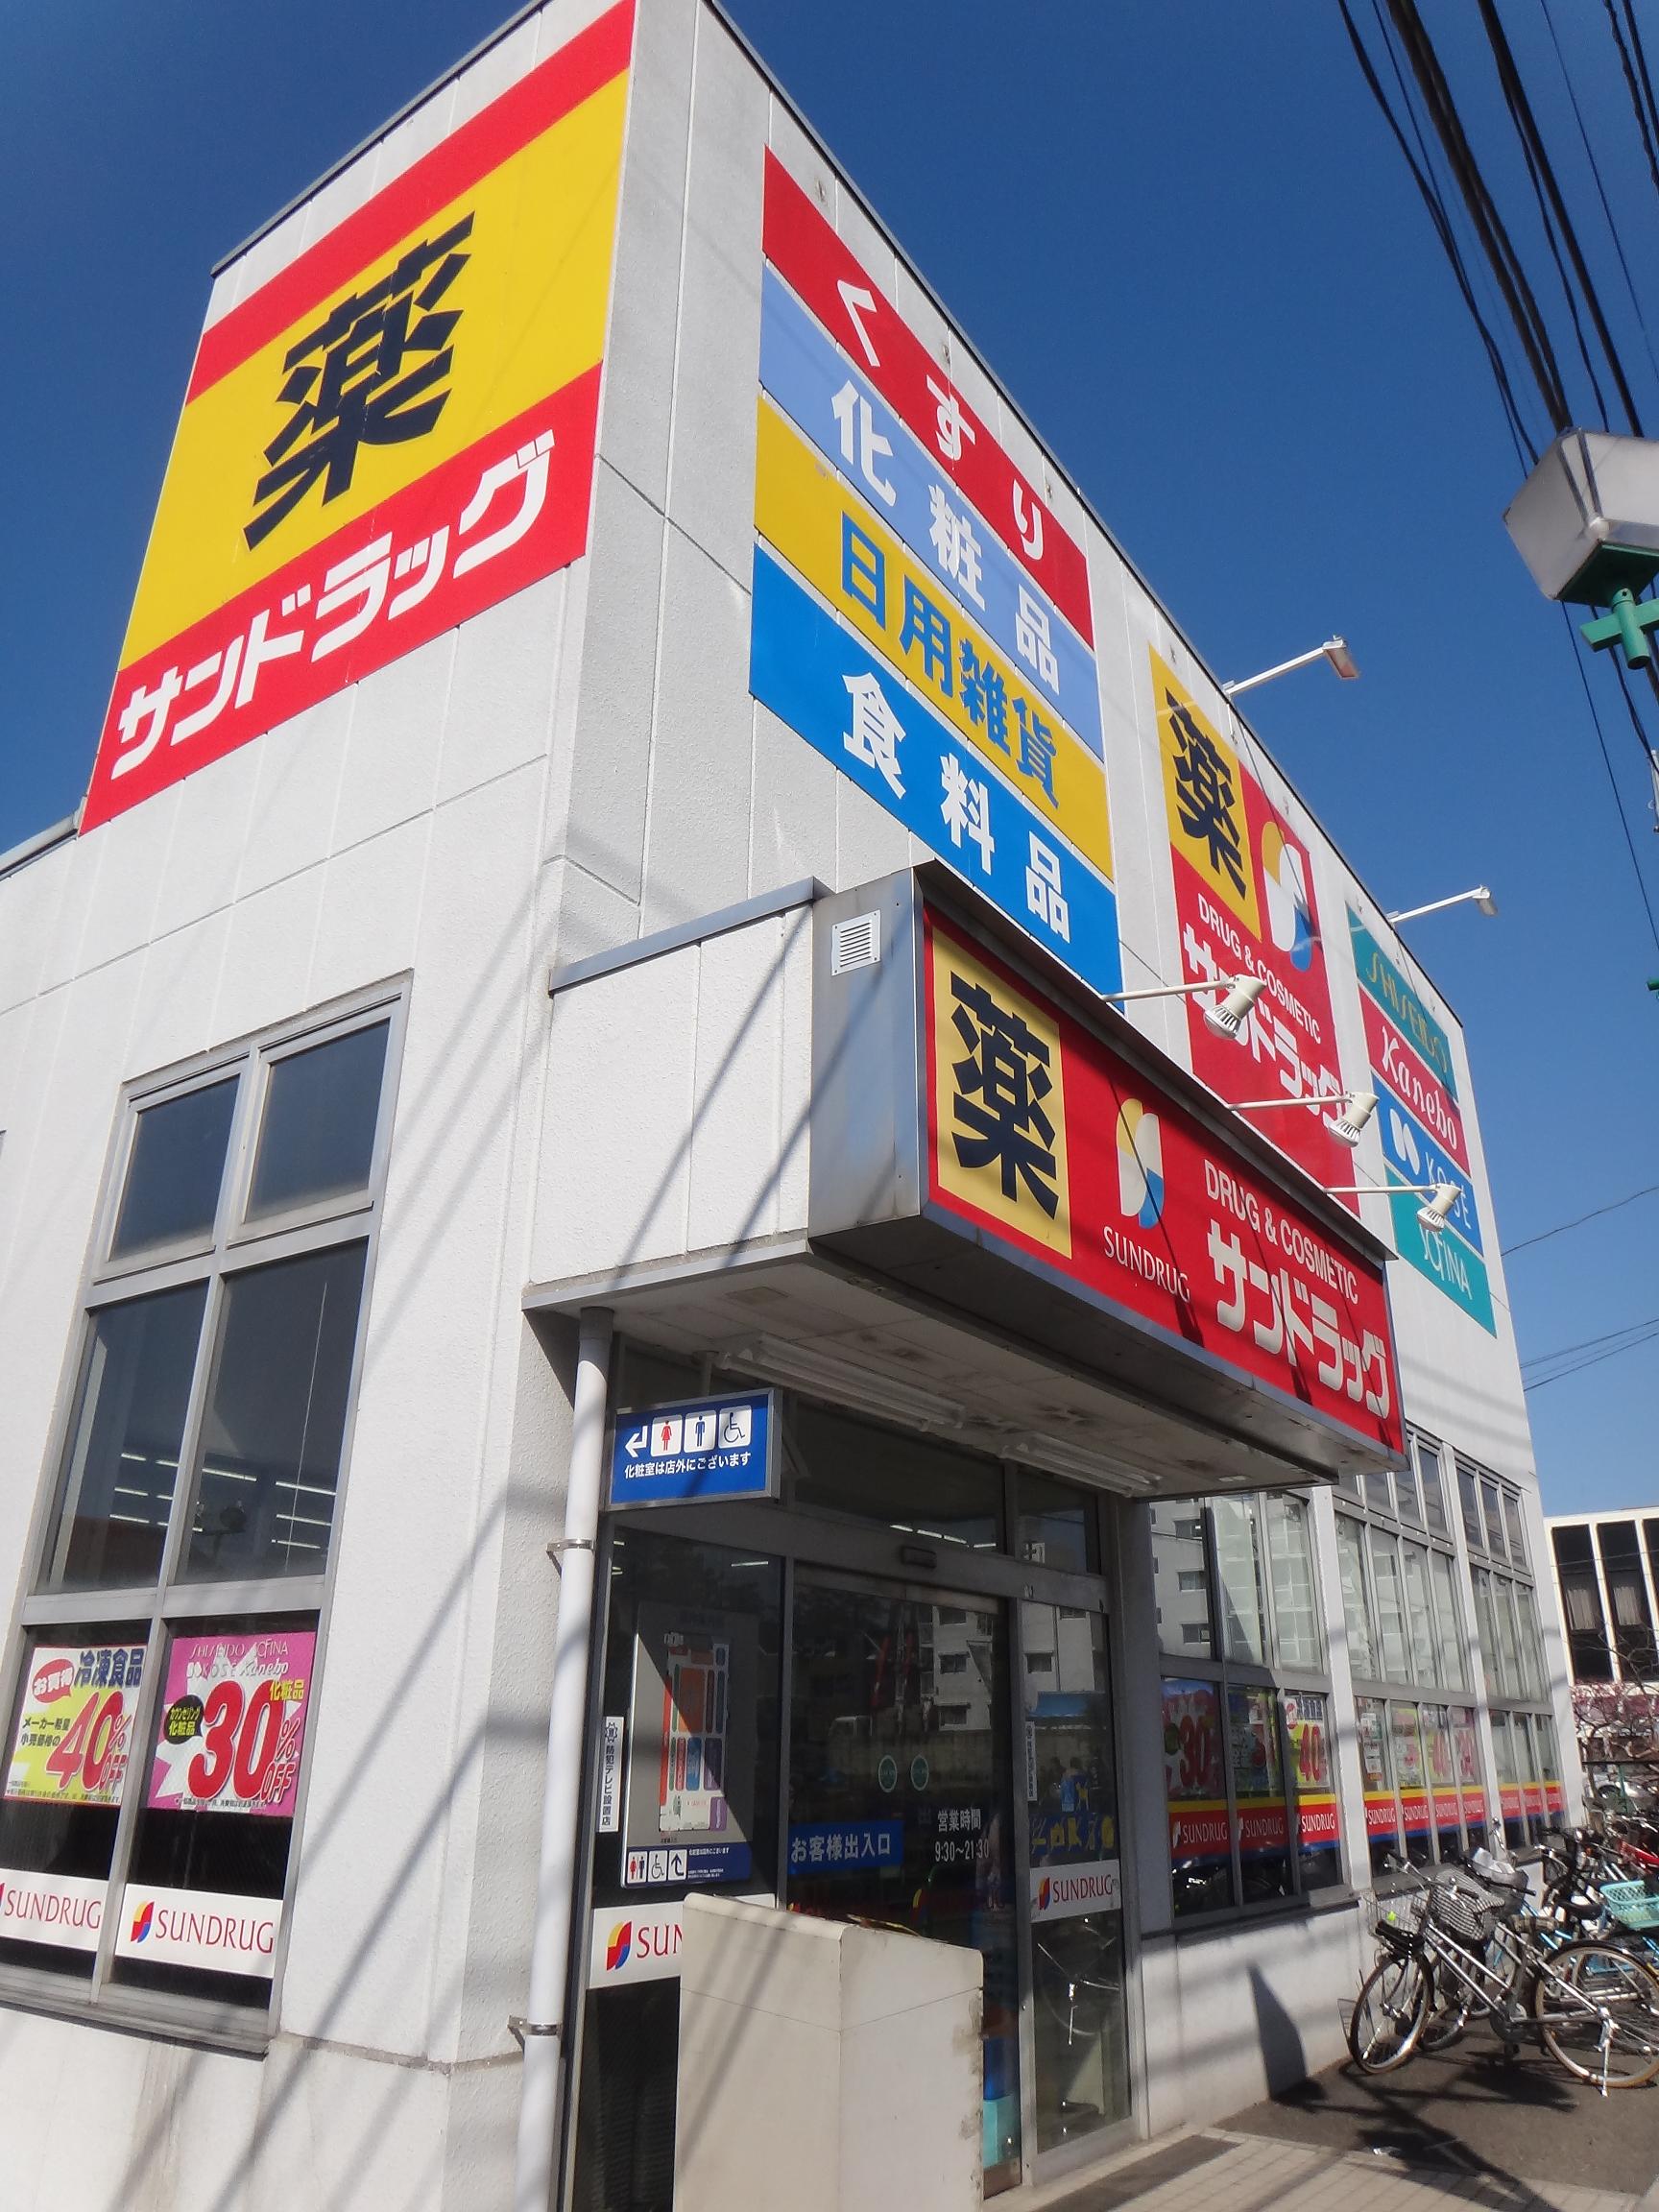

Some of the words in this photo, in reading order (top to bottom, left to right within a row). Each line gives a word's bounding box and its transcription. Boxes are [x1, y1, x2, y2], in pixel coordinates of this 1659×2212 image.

[242, 210, 475, 551] 薬
[836, 280, 1044, 564] くすり
[830, 379, 1060, 696] 化粧品
[111, 429, 555, 781] サンドラッグ
[841, 511, 1059, 809] 日用雑貨
[843, 672, 1070, 944] 食料品
[1166, 688, 1247, 900] 薬
[1197, 893, 1242, 960] DRUG
[1243, 945, 1256, 974] &
[1257, 960, 1322, 1045] COSMETIC
[1183, 922, 1344, 1130] サドラッグ
[1366, 952, 1448, 1074] SHISEIDO
[950, 970, 1059, 1220] 薬
[1382, 1025, 1457, 1151] Kanebo
[1204, 1159, 1262, 1233] DRUG
[1264, 1207, 1278, 1246] &
[1280, 1218, 1359, 1305] COSMETIC
[1103, 1225, 1191, 1304] SUNDRUG
[1207, 1218, 1390, 1420] サンドラッグ
[624, 1451, 752, 1479] 化粧室は店外にございます
[34, 1668, 73, 1696] お買得
[73, 1647, 145, 1688] 冷凍食品
[240, 1657, 289, 1676] Kanebo
[270, 1678, 304, 1702] 化粧品
[168, 1719, 196, 1737] 化粧品
[169, 1706, 201, 1720] カウンセリング
[100, 1753, 128, 1792] OFF
[260, 1762, 296, 1804] OFF
[937, 1808, 981, 1833] 営業時間
[1182, 1821, 1228, 1844] SUNDRUG
[1245, 1816, 1284, 1839] SUNDRUG
[1301, 1813, 1335, 1833] SUNDRUG
[1367, 1806, 1396, 1825] SUNDRUG
[790, 1832, 891, 1863] お客様出入口
[4, 1888, 102, 1931] SUNDRUG
[1052, 1874, 1114, 1904] SUNDRUG
[155, 1909, 275, 1955] SUNDRUG
